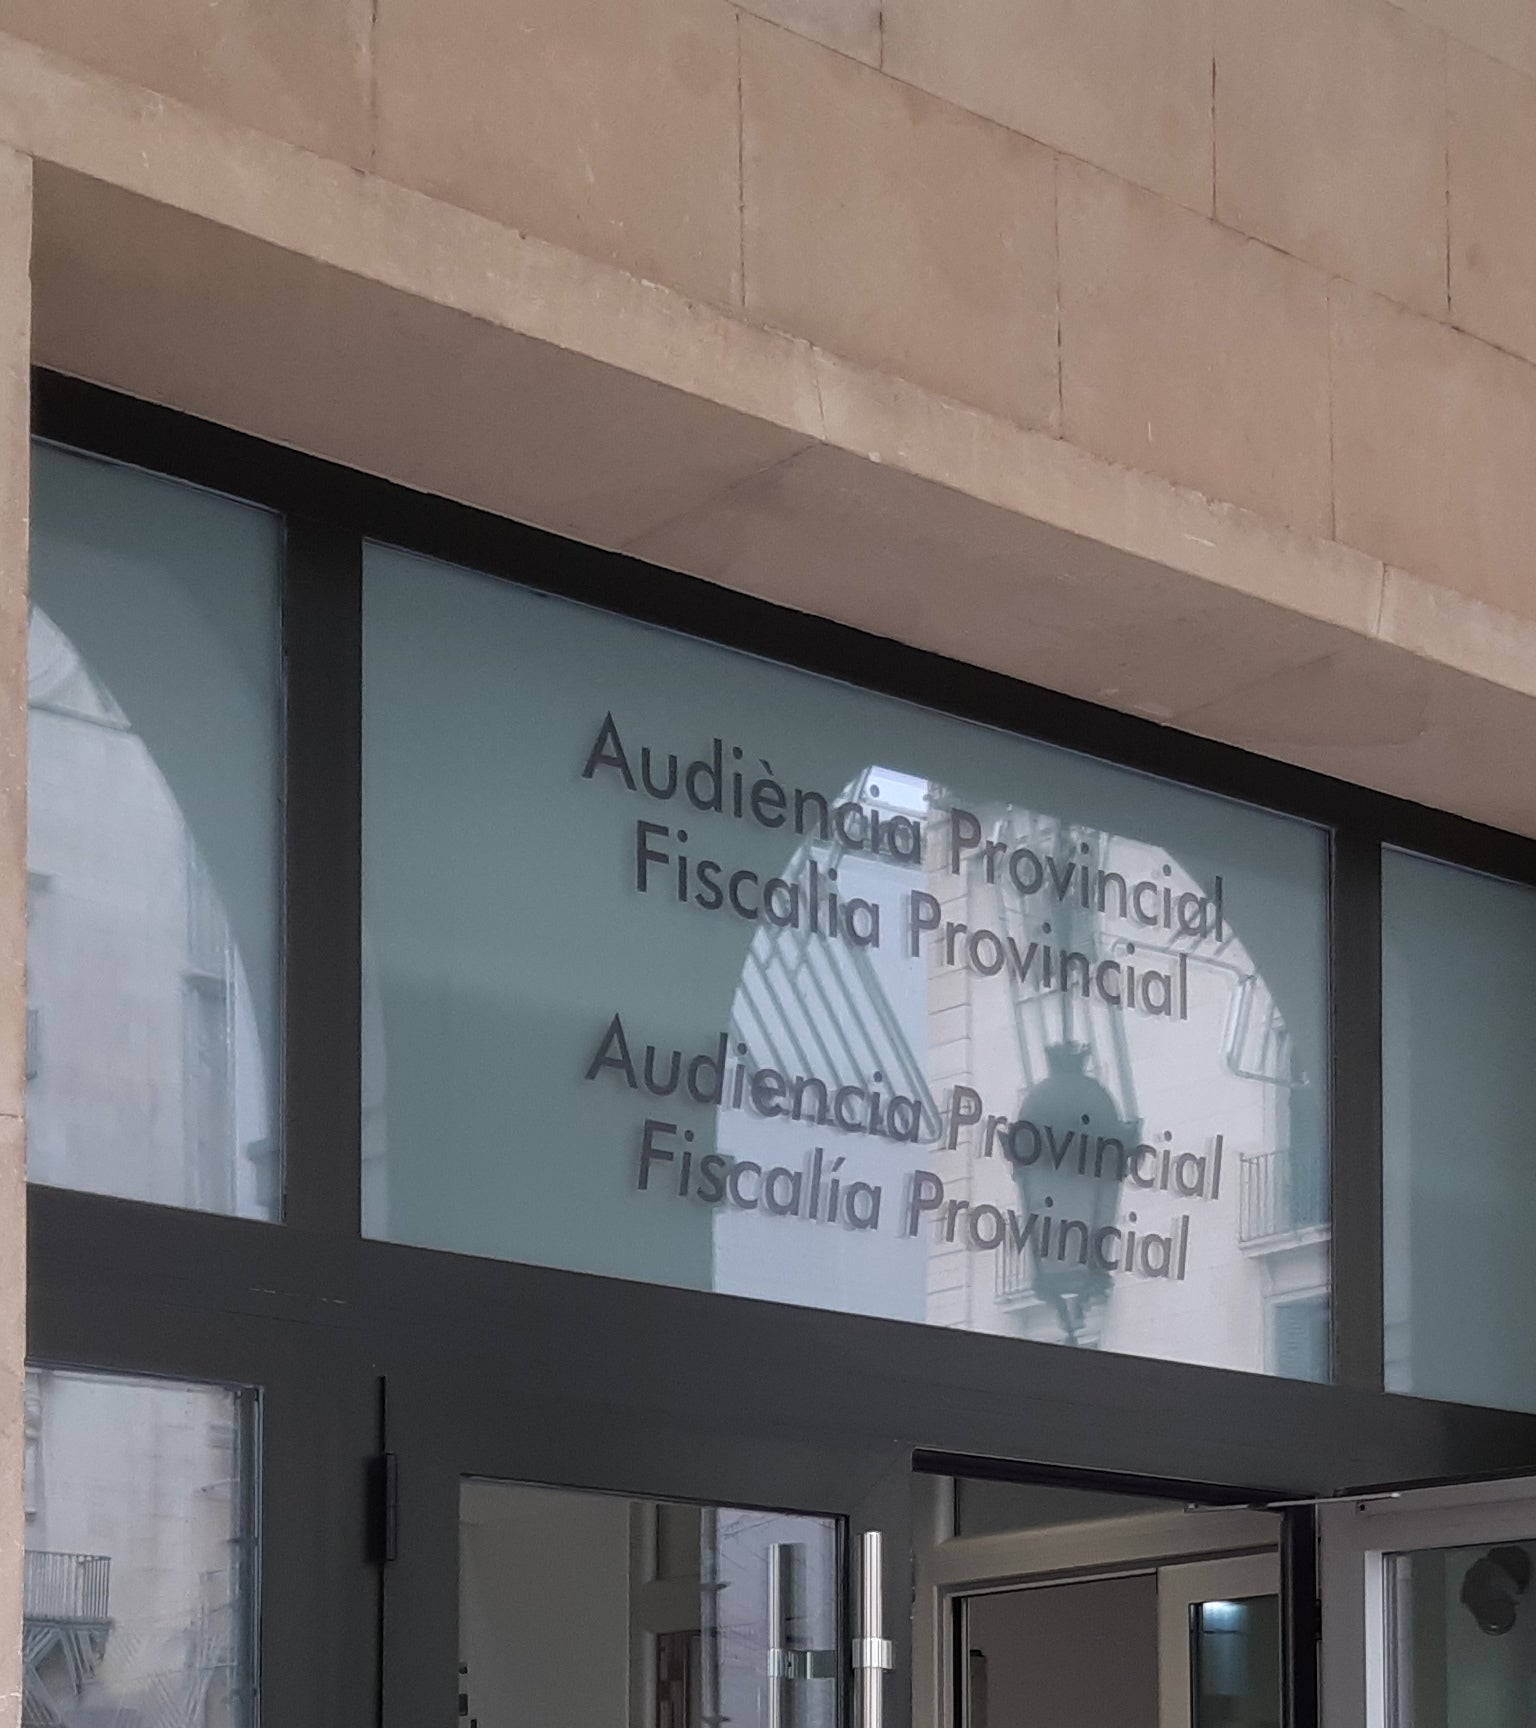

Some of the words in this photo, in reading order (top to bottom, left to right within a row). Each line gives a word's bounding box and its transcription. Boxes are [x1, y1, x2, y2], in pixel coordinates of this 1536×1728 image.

[582, 711, 923, 861] Audiència
[950, 807, 1224, 942] Provincial
[635, 819, 881, 948] Fiscalia
[910, 890, 1189, 1021] Provincial
[585, 1012, 923, 1144] Audiencia
[948, 1085, 1224, 1201] Provincial
[636, 1119, 882, 1231] Fiscalía
[908, 1169, 1191, 1281] Provincial
